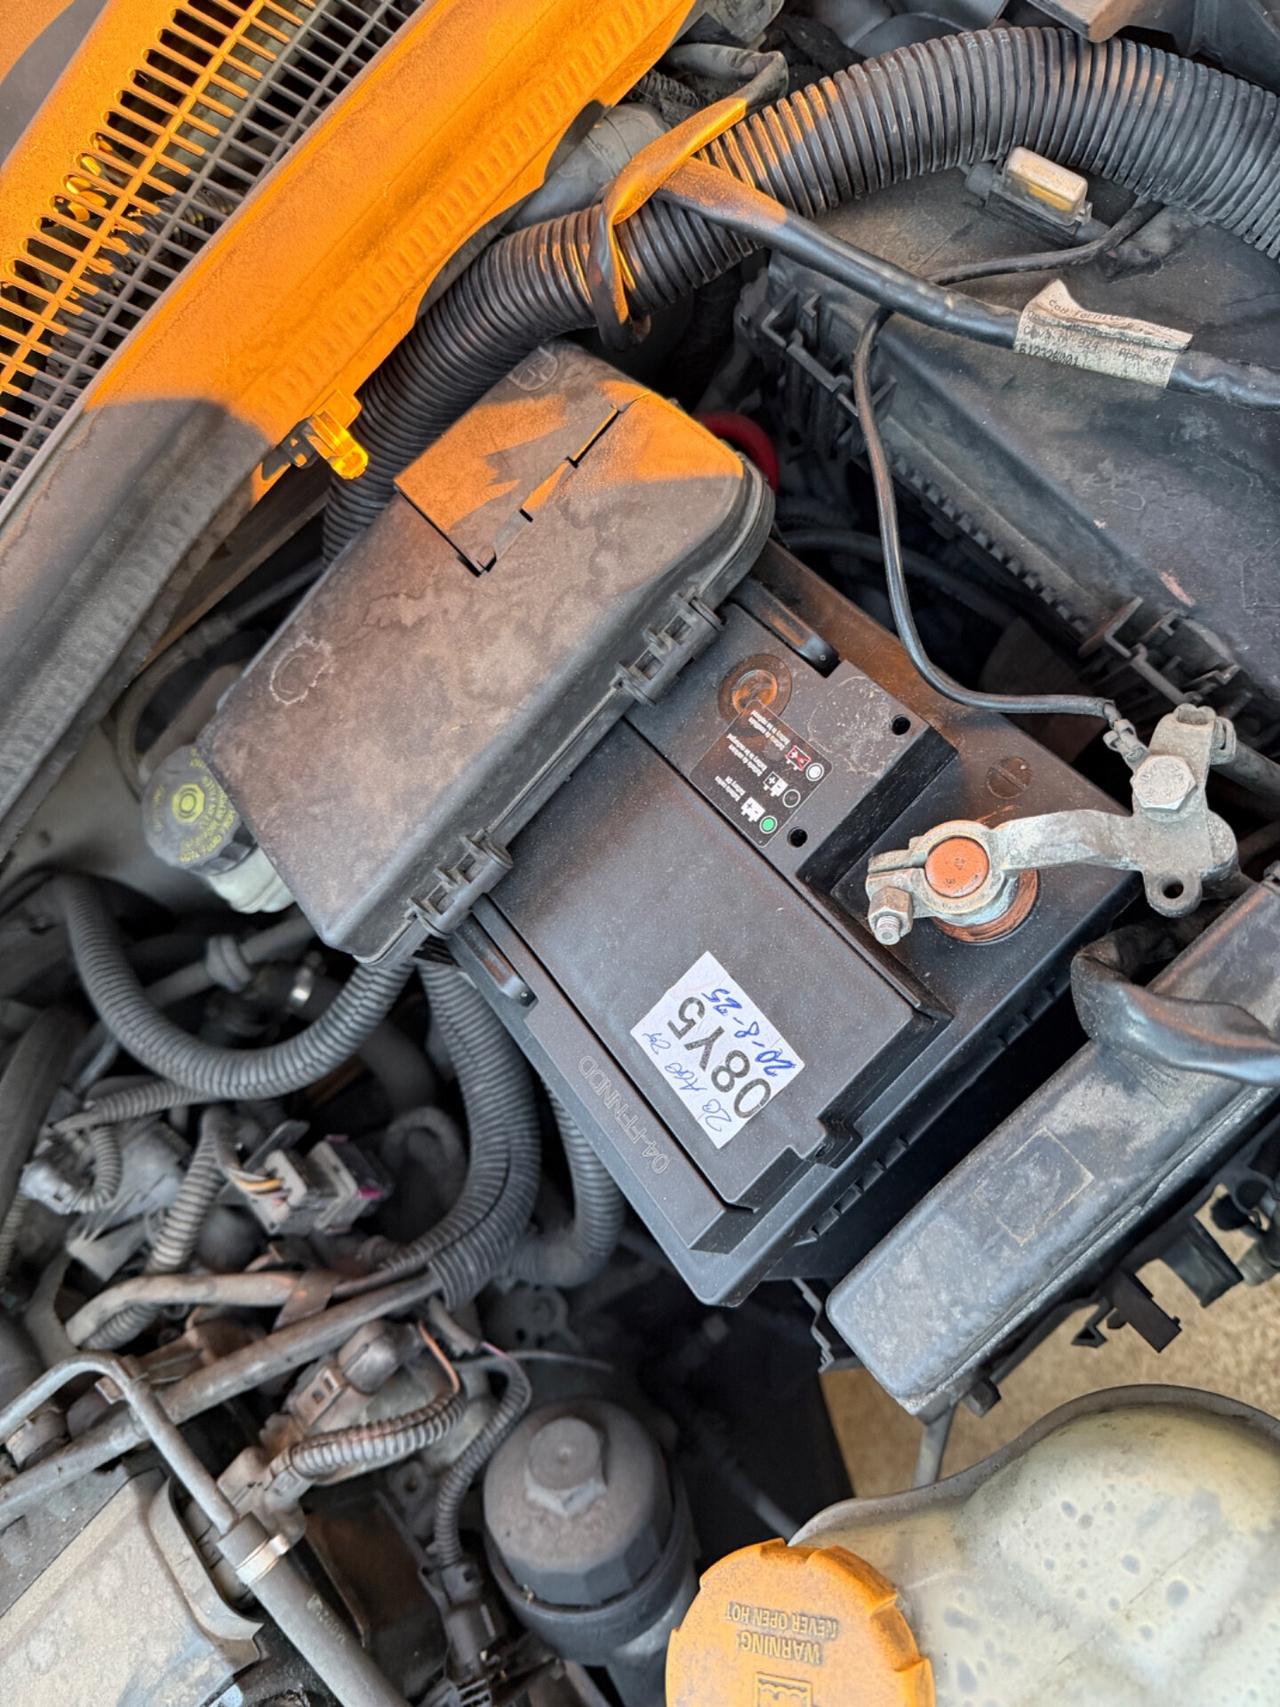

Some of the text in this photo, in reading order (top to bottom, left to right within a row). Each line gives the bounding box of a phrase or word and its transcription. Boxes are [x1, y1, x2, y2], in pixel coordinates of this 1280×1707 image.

[666, 996, 770, 1119] 08Y5
[726, 1602, 749, 1623] HOT
[753, 1607, 787, 1630] OPEN
[736, 1631, 819, 1664] WARNING
